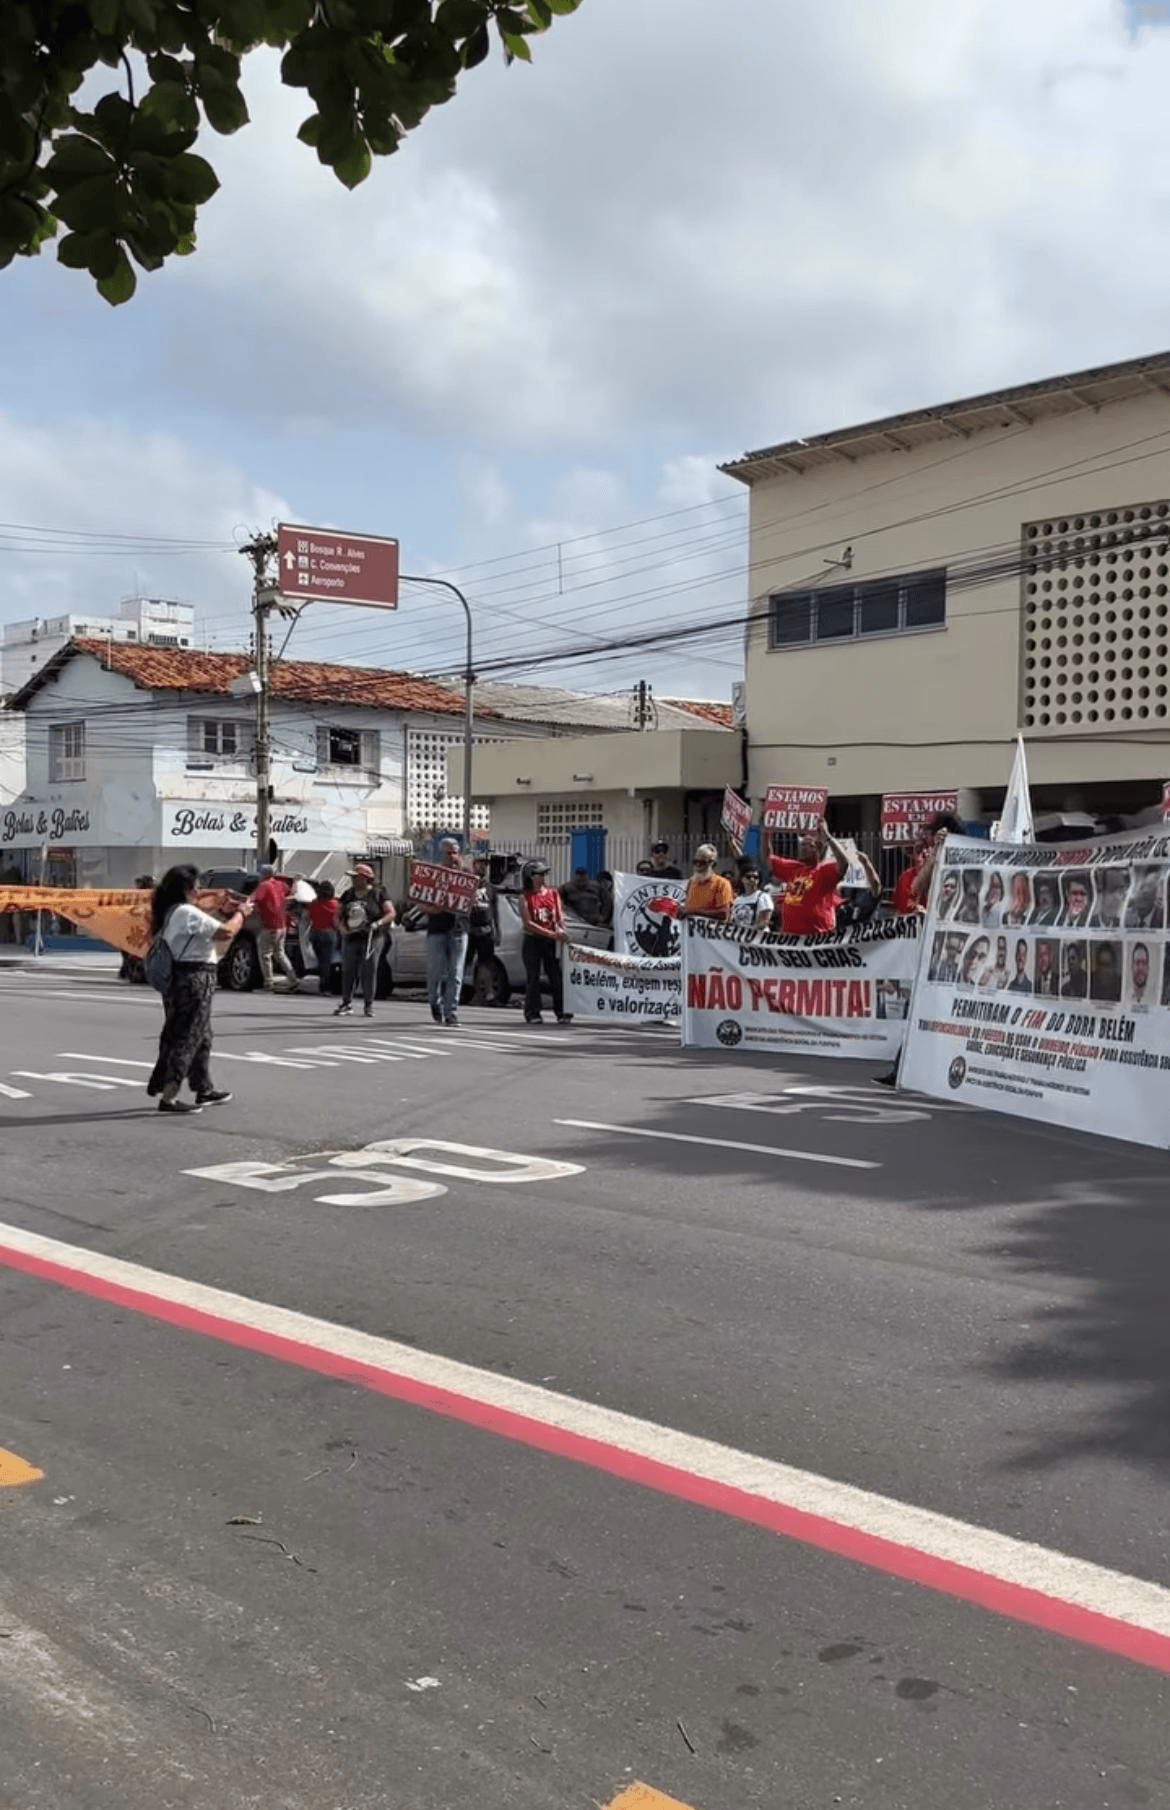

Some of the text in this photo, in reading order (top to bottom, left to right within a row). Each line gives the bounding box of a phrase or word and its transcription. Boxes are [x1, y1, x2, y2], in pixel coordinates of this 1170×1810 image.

[311, 574, 345, 589] Aeroporto
[768, 789, 825, 803] ESTAMOS
[883, 798, 955, 813] ESTAMOS
[36, 810, 48, 834] &
[171, 808, 225, 836] Bolas
[229, 812, 247, 833] &
[764, 810, 820, 831] GREVE
[414, 865, 475, 890] ESTAMOS
[409, 883, 471, 912] GREVE
[848, 916, 918, 944] ACABAR
[739, 945, 867, 968] COM SEU CRAS.
[570, 968, 582, 985] de
[622, 974, 661, 994] exigem
[687, 966, 871, 1018] NÃO PERMITA!
[597, 996, 605, 1011] e
[951, 998, 1011, 1024] PERMITIRAM
[1010, 1006, 1023, 1026] O
[1021, 1008, 1048, 1030] FIM
[1045, 1011, 1065, 1032] DO
[1098, 1014, 1136, 1043] BELÉM
[180, 1138, 588, 1207] 50
